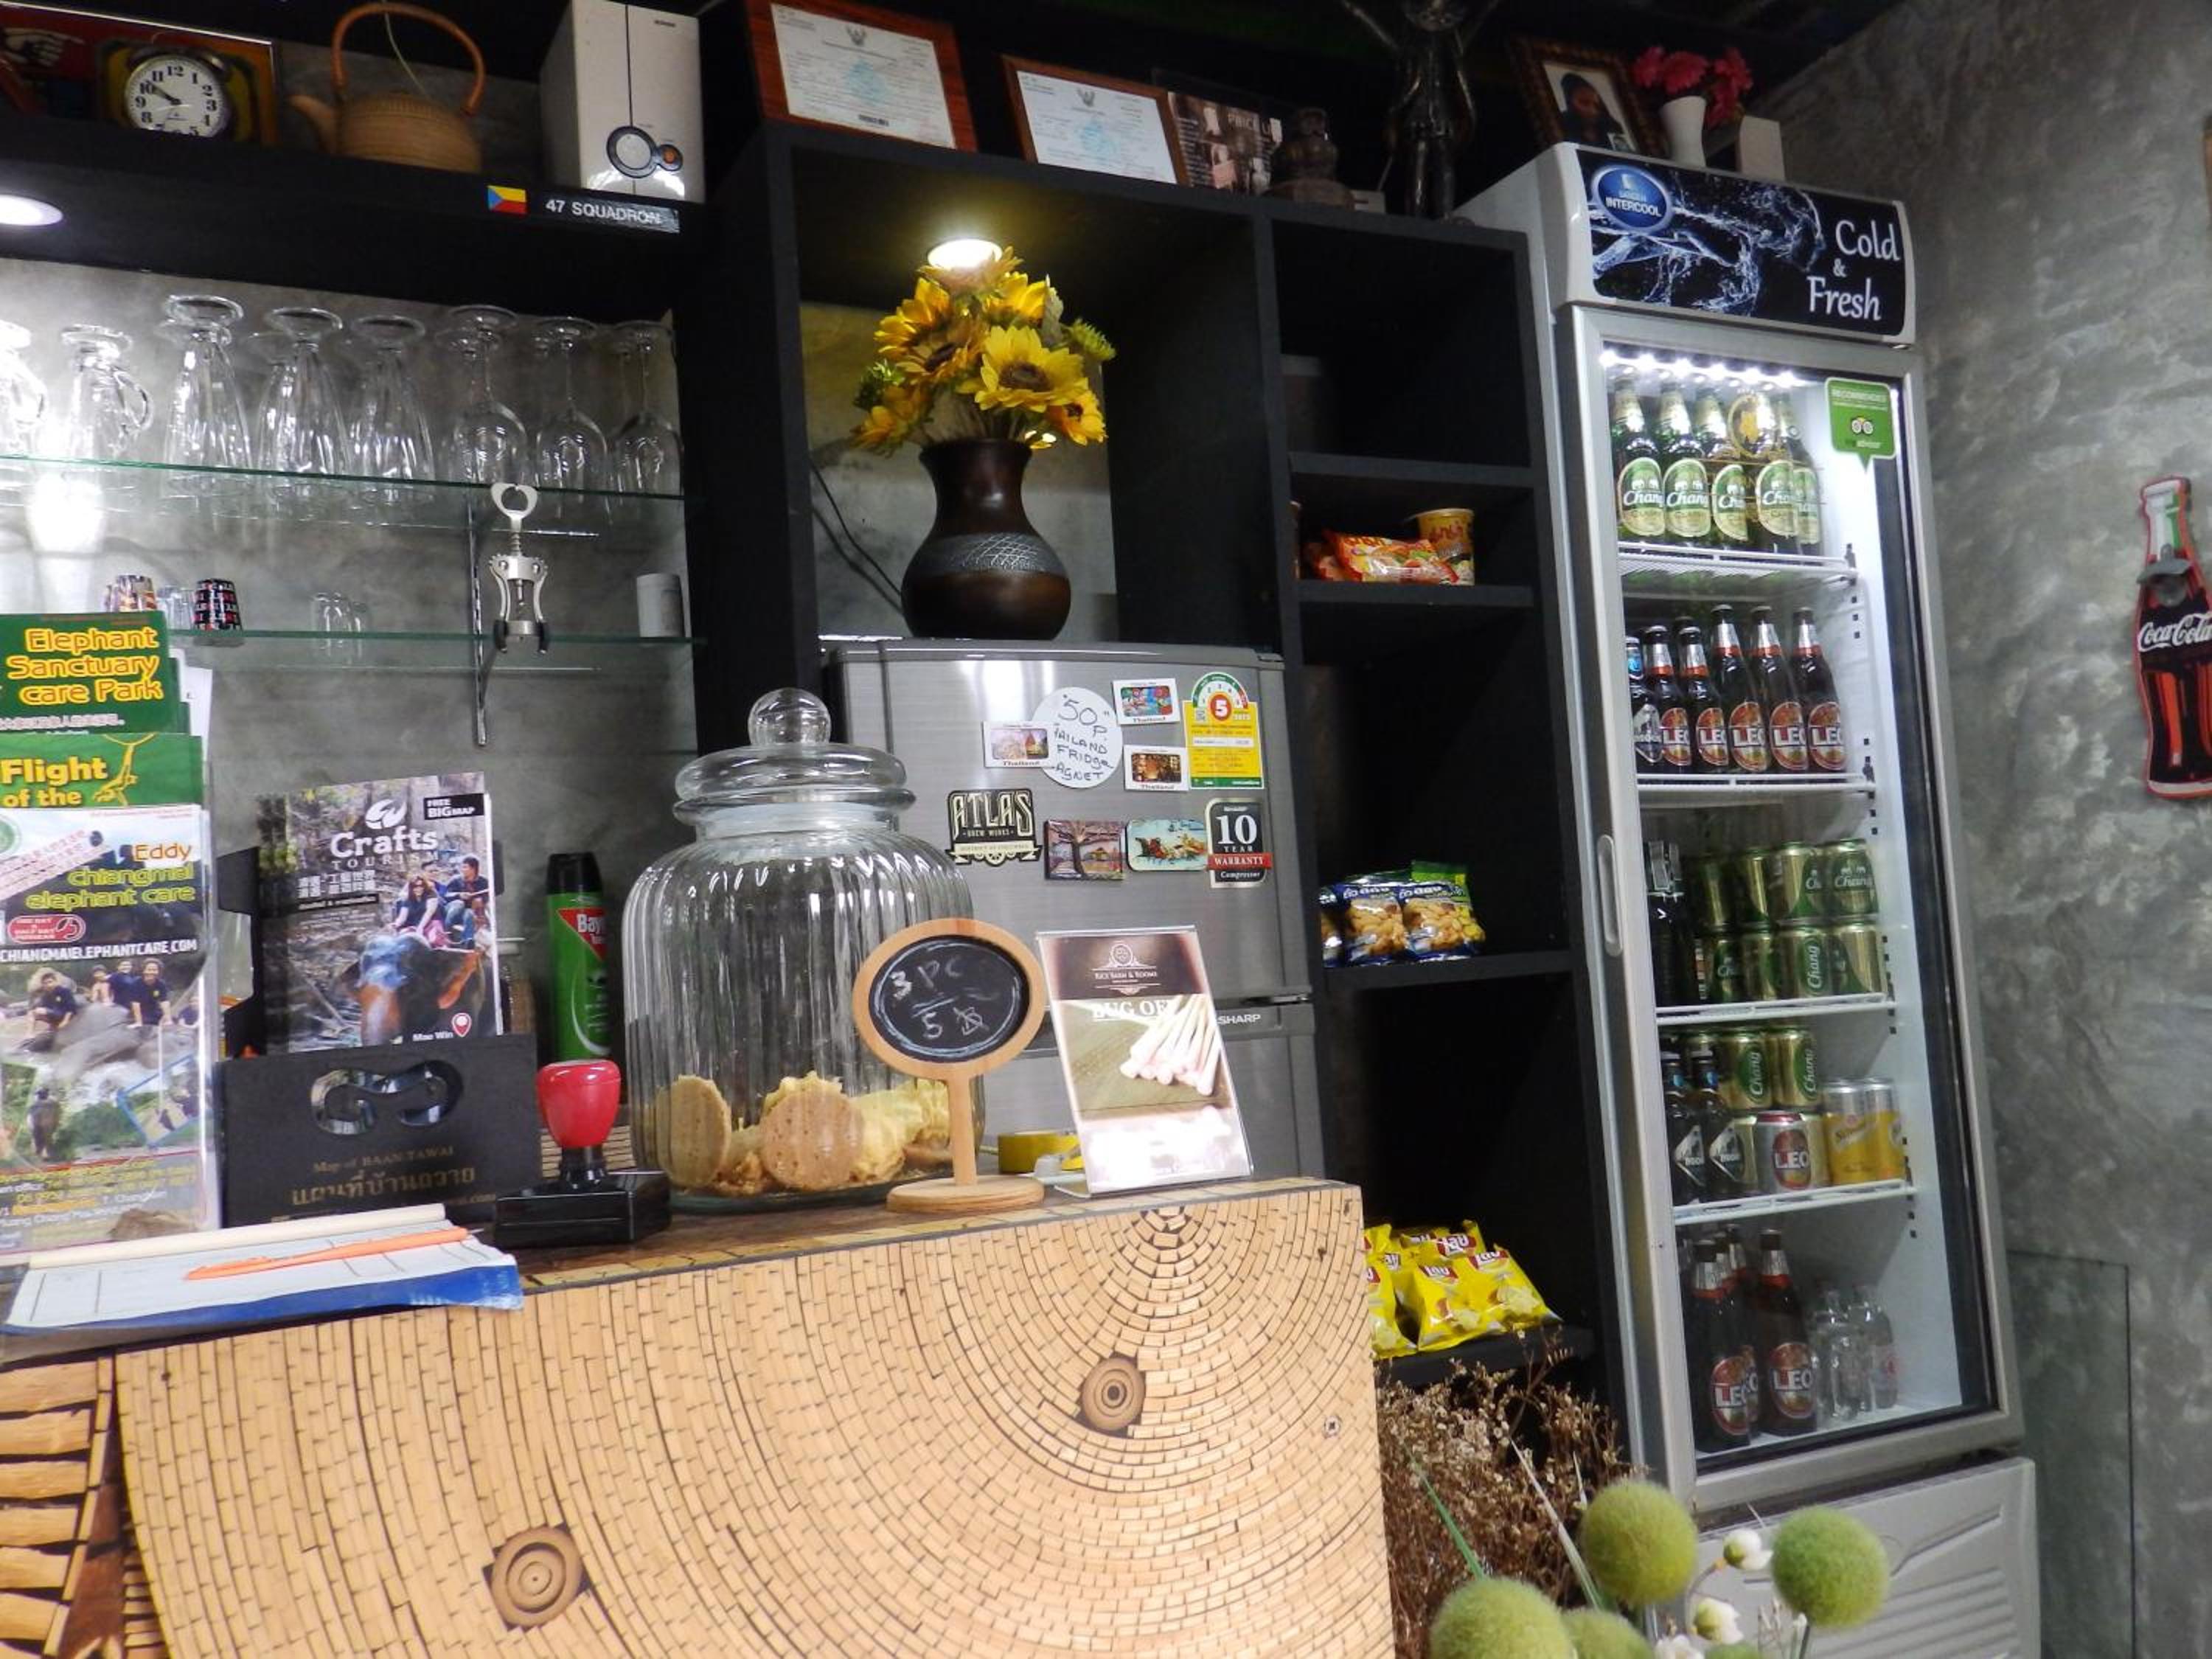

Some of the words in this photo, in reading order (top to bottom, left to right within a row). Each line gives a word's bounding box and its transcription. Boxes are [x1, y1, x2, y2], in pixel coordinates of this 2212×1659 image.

[152, 70, 164, 82] 11
[167, 66, 184, 77] 12
[192, 72, 198, 84] 1
[202, 84, 213, 97] 2
[135, 96, 146, 108] 9
[206, 100, 218, 111] 3
[546, 199, 566, 213] 47
[571, 201, 663, 224] SQUADRON
[1605, 197, 1663, 218] INTERCOOL
[1835, 220, 1900, 261] Cold
[1833, 258, 1847, 277] &
[1807, 276, 1882, 321] Fresh
[25, 627, 159, 655] Elephant
[6, 655, 159, 681] Sanctuary
[19, 684, 90, 706] care
[94, 678, 164, 703] Park
[1214, 699, 1228, 718] 5
[0, 756, 108, 787] Flight
[2, 788, 30, 807] of
[38, 787, 83, 806] the
[428, 807, 451, 818] BIG
[951, 791, 1033, 841] ATLAS
[1215, 815, 1257, 844] 10
[133, 843, 192, 861] Eddy
[331, 825, 439, 858] Crafts
[1214, 856, 1263, 866] WARRANTY
[26, 888, 138, 913] elephant
[141, 886, 196, 904] care
[1807, 945, 1822, 990] Chang
[890, 970, 912, 1000] 3
[922, 1011, 943, 1040] 5
[1217, 1013, 1262, 1025] SHARP
[1750, 1051, 1764, 1096] Chang
[1774, 1151, 1810, 1169] LEO
[1773, 1369, 1813, 1391] LEO
